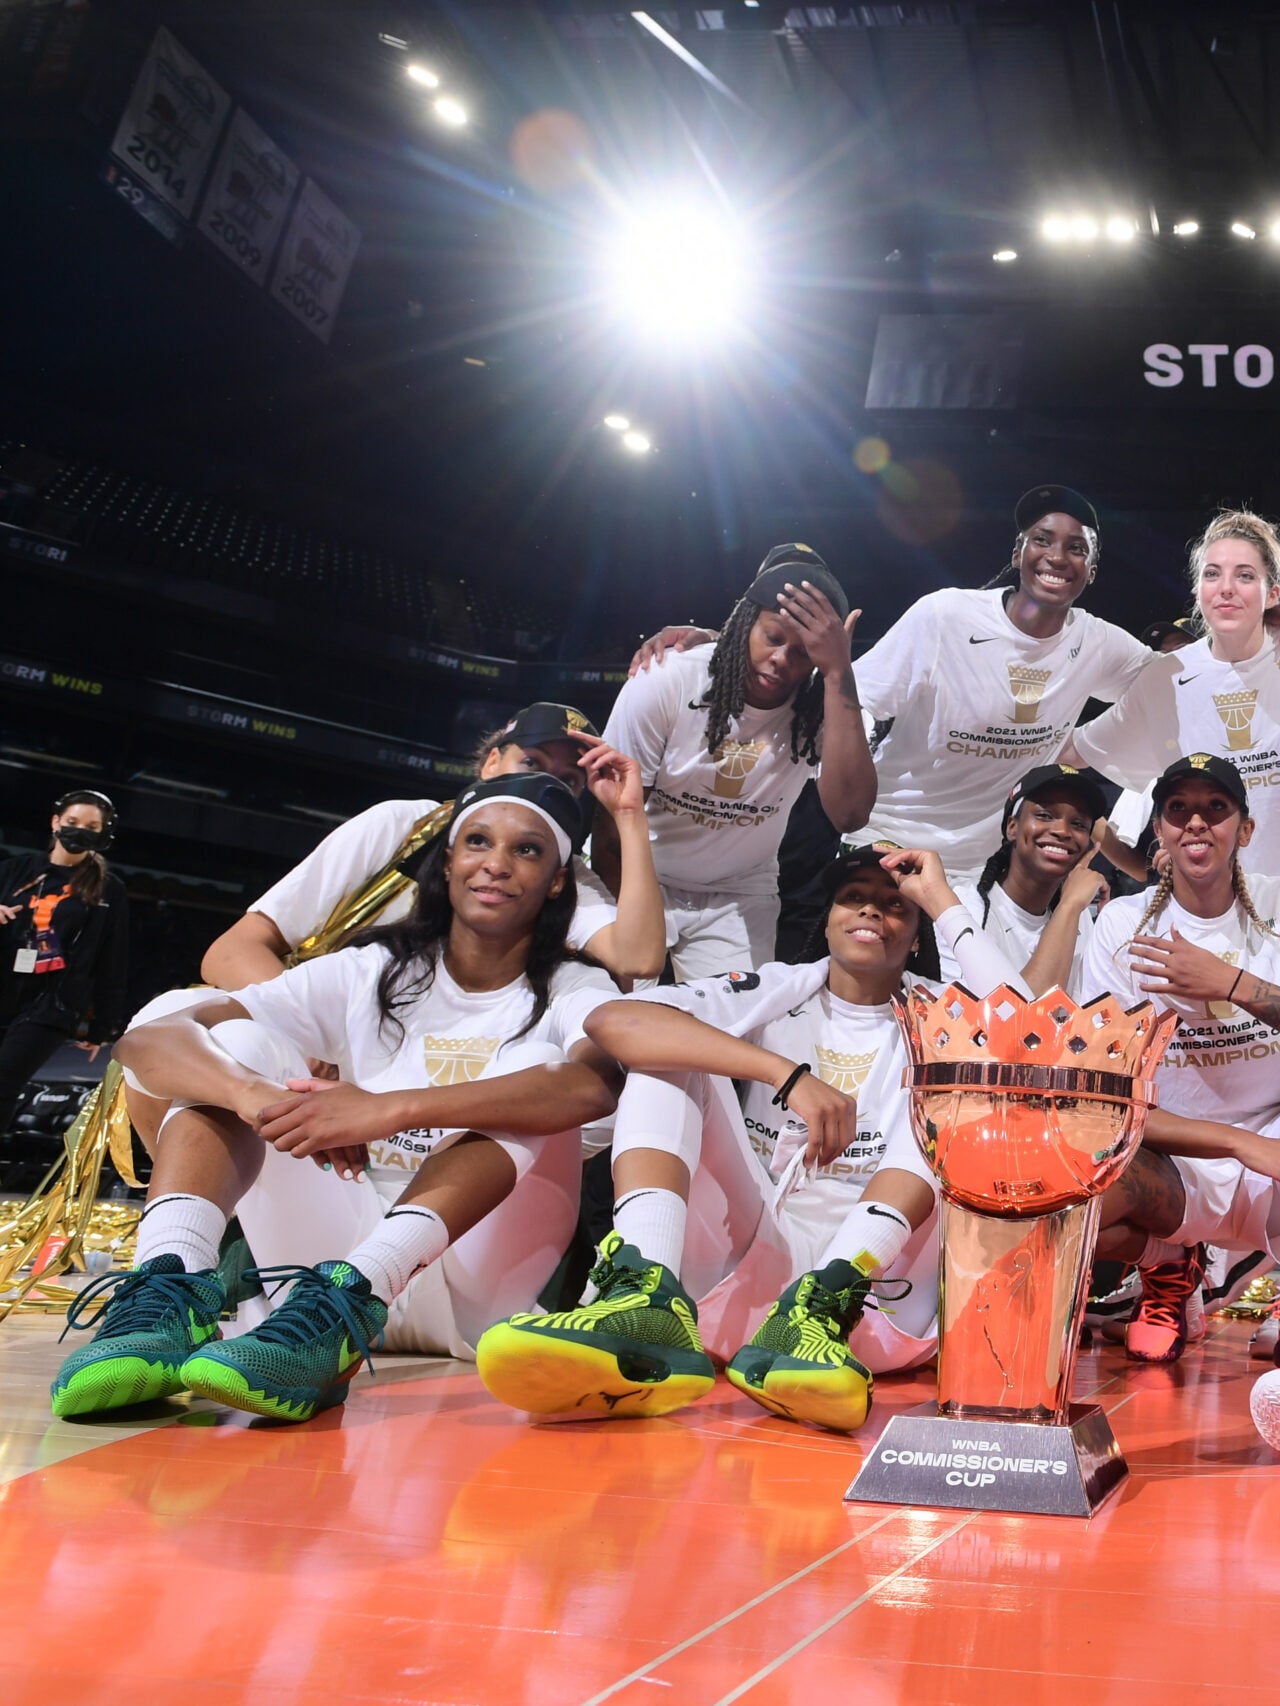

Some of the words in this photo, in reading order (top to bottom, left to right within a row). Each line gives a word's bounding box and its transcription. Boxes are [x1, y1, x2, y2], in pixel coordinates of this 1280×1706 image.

[127, 135, 188, 199] 2014
[117, 177, 145, 204] 29
[209, 211, 262, 268] 2009
[280, 276, 330, 326] 2007
[1, 660, 47, 683] ORM
[51, 672, 104, 695] WINS
[462, 662, 499, 678] WINS
[187, 704, 248, 730] STORM
[252, 719, 297, 740] WINS
[986, 726, 1017, 736] 2021
[1020, 725, 1053, 736] WNBA
[1240, 750, 1279, 763] WNBA
[682, 791, 716, 807] 2021
[1178, 1027, 1214, 1038] 2021
[1218, 1018, 1262, 1035] WNBA
[1168, 1030, 1269, 1050] MMISSIONER'S
[952, 1439, 1001, 1452] WNBA
[880, 1449, 1068, 1475] COMMISSIONER'S
[945, 1471, 996, 1487] CUP
